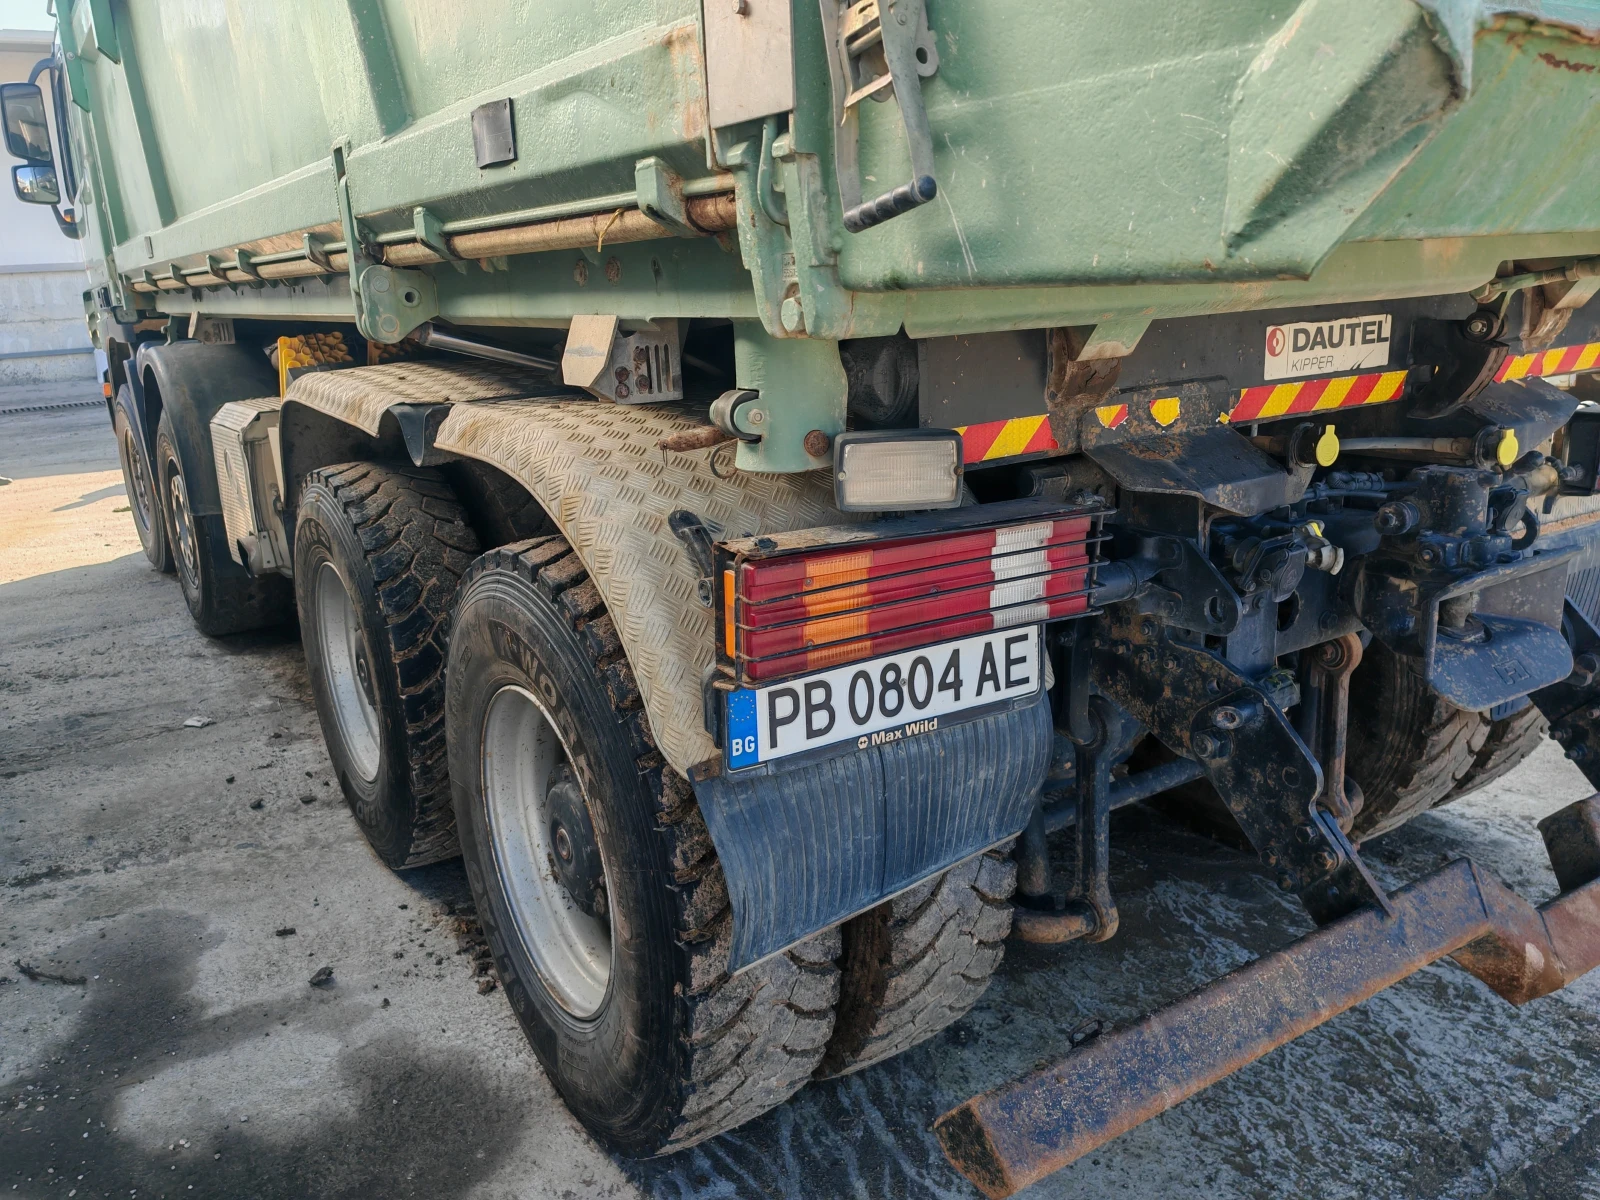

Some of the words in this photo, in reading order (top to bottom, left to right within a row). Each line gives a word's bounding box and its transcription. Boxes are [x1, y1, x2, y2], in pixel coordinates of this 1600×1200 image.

[1292, 320, 1389, 352] DAUTEL
[1291, 356, 1334, 372] KIPPER
[767, 678, 836, 749] PB
[848, 648, 964, 726] 0804
[975, 633, 1031, 698] AE
[731, 735, 756, 757] BG
[871, 727, 904, 746] Max
[905, 717, 938, 736] Wild
